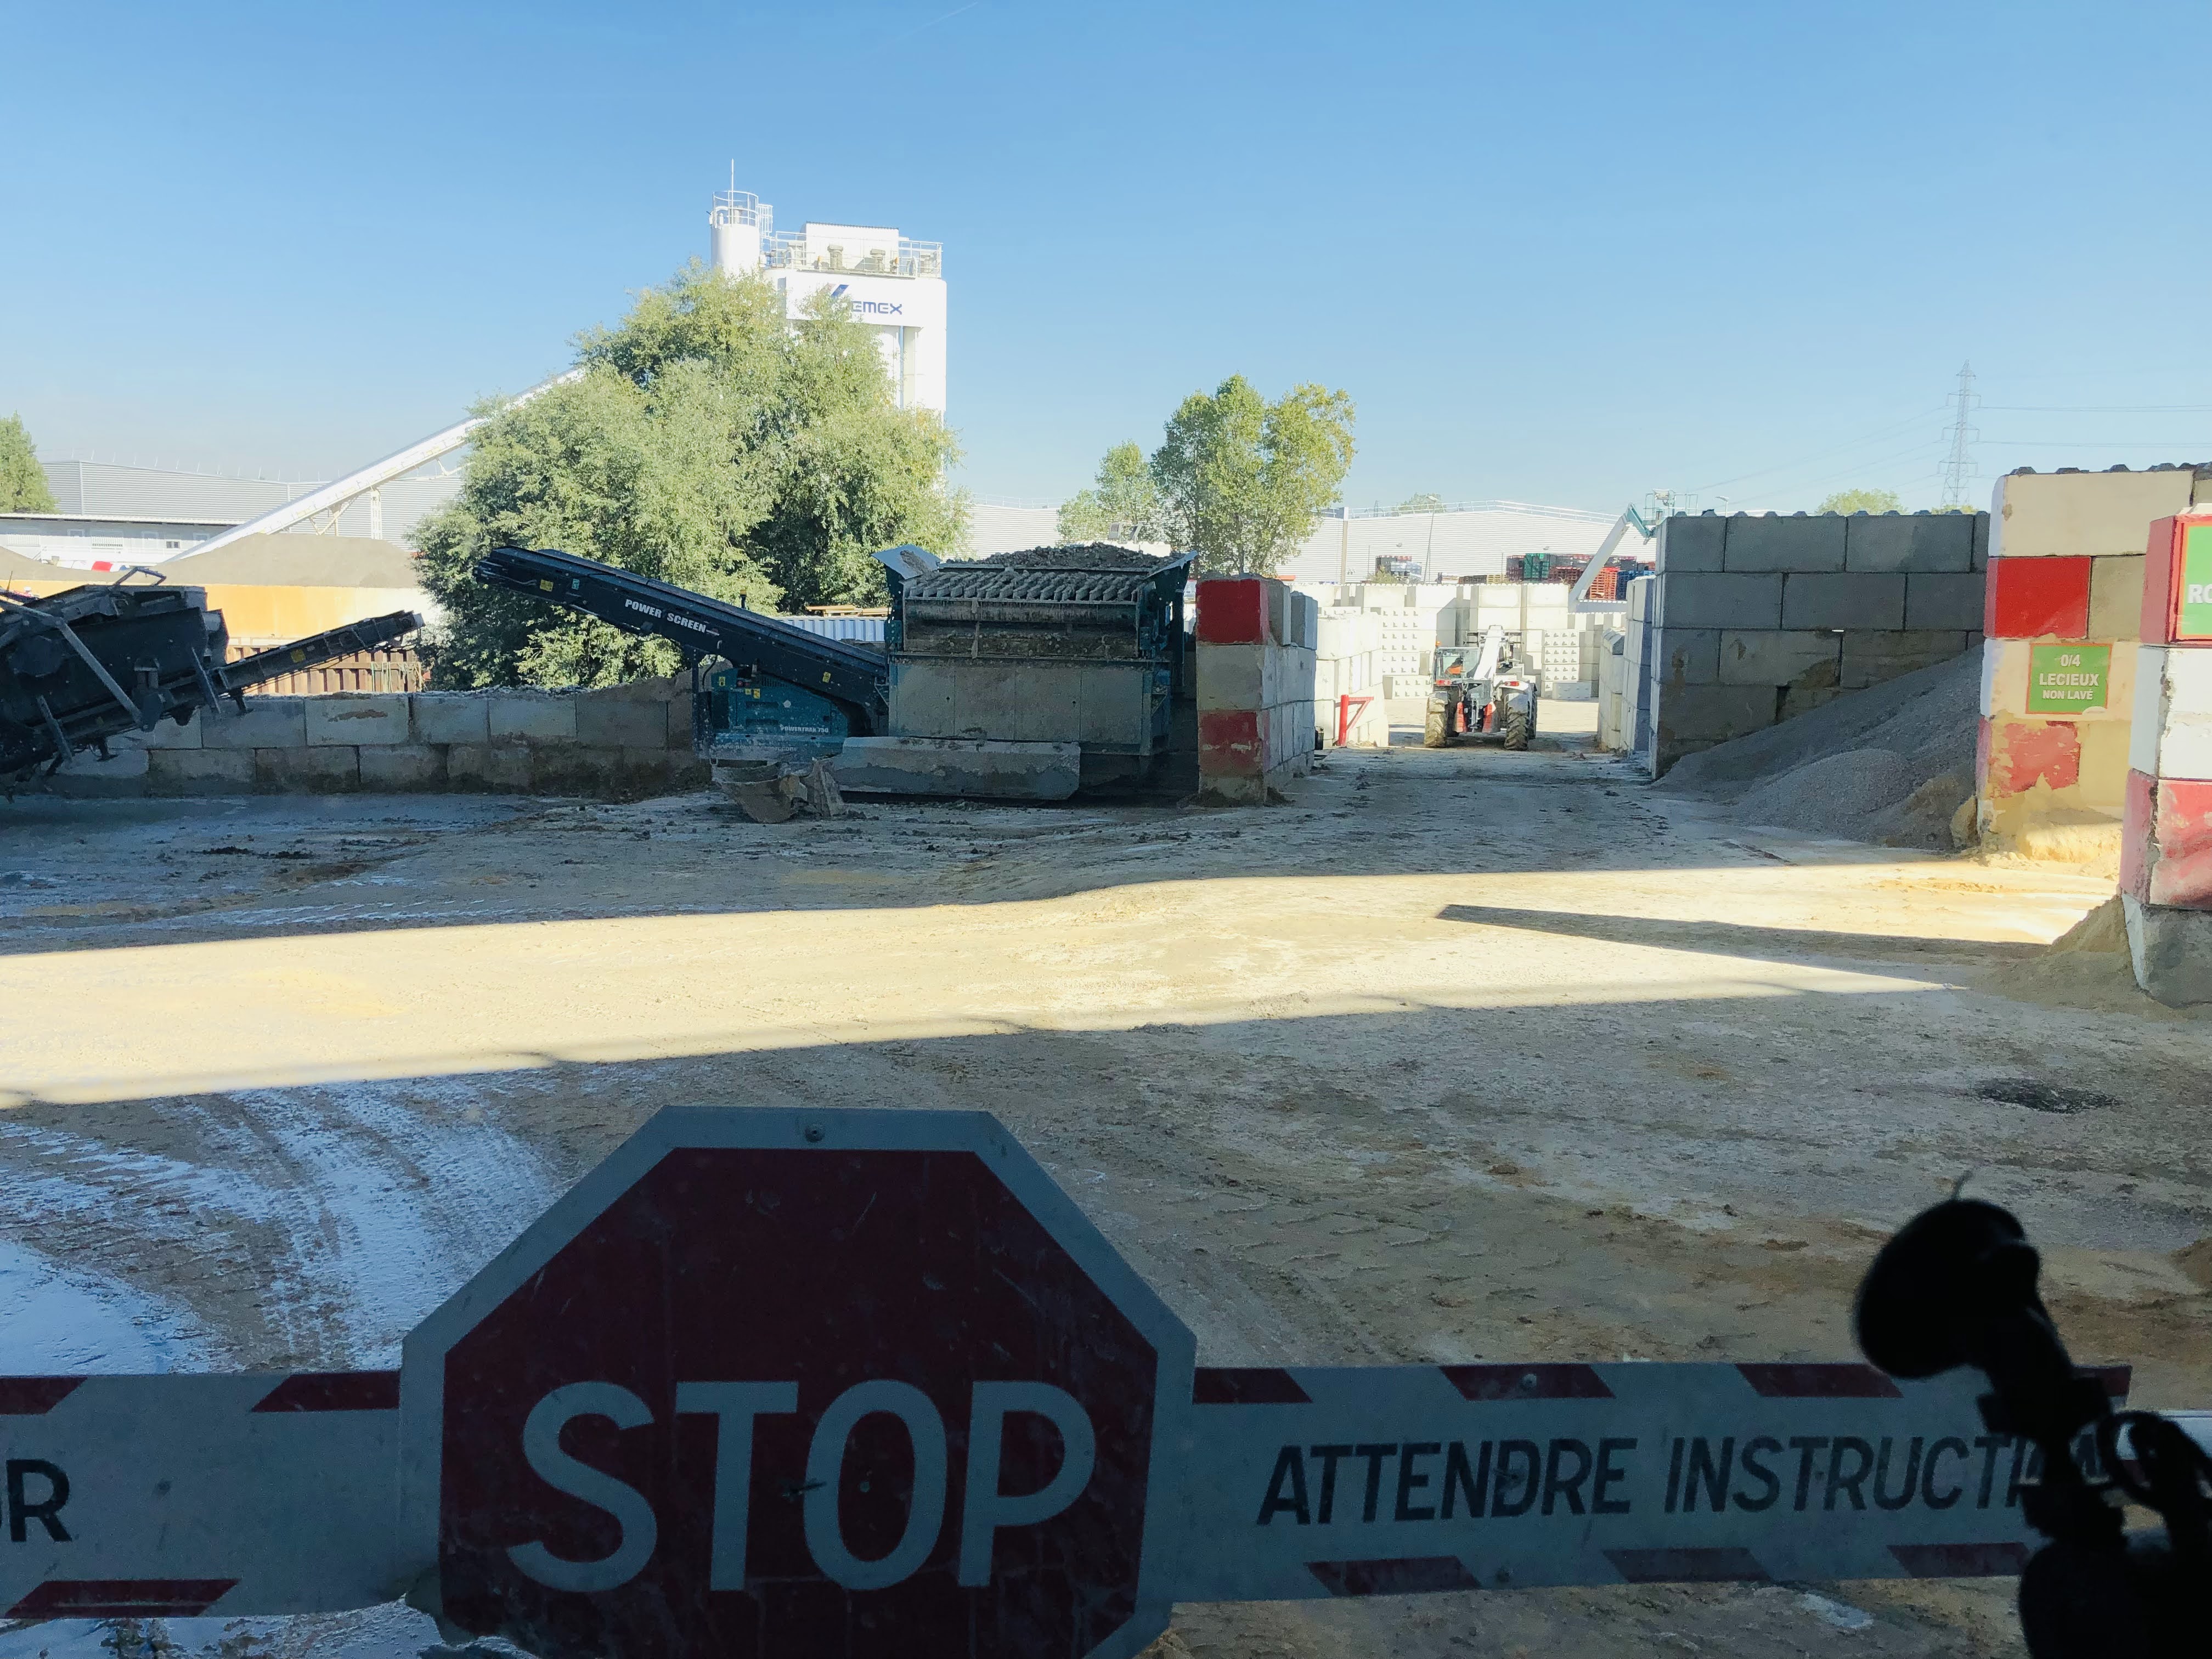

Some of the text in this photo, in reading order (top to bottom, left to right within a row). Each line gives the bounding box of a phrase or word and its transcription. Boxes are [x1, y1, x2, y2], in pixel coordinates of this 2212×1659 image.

[851, 301, 902, 315] EMEX
[625, 599, 707, 633] POWER SCREEN
[2061, 654, 2081, 667] 0/4
[2039, 673, 2099, 686] LECIEUX
[2042, 688, 2094, 700] NON LAVÉ
[506, 1380, 1096, 1593] STOP
[1256, 1435, 2104, 1526] ATTENDRE INSTRUCTI
[0, 1459, 73, 1543] R
